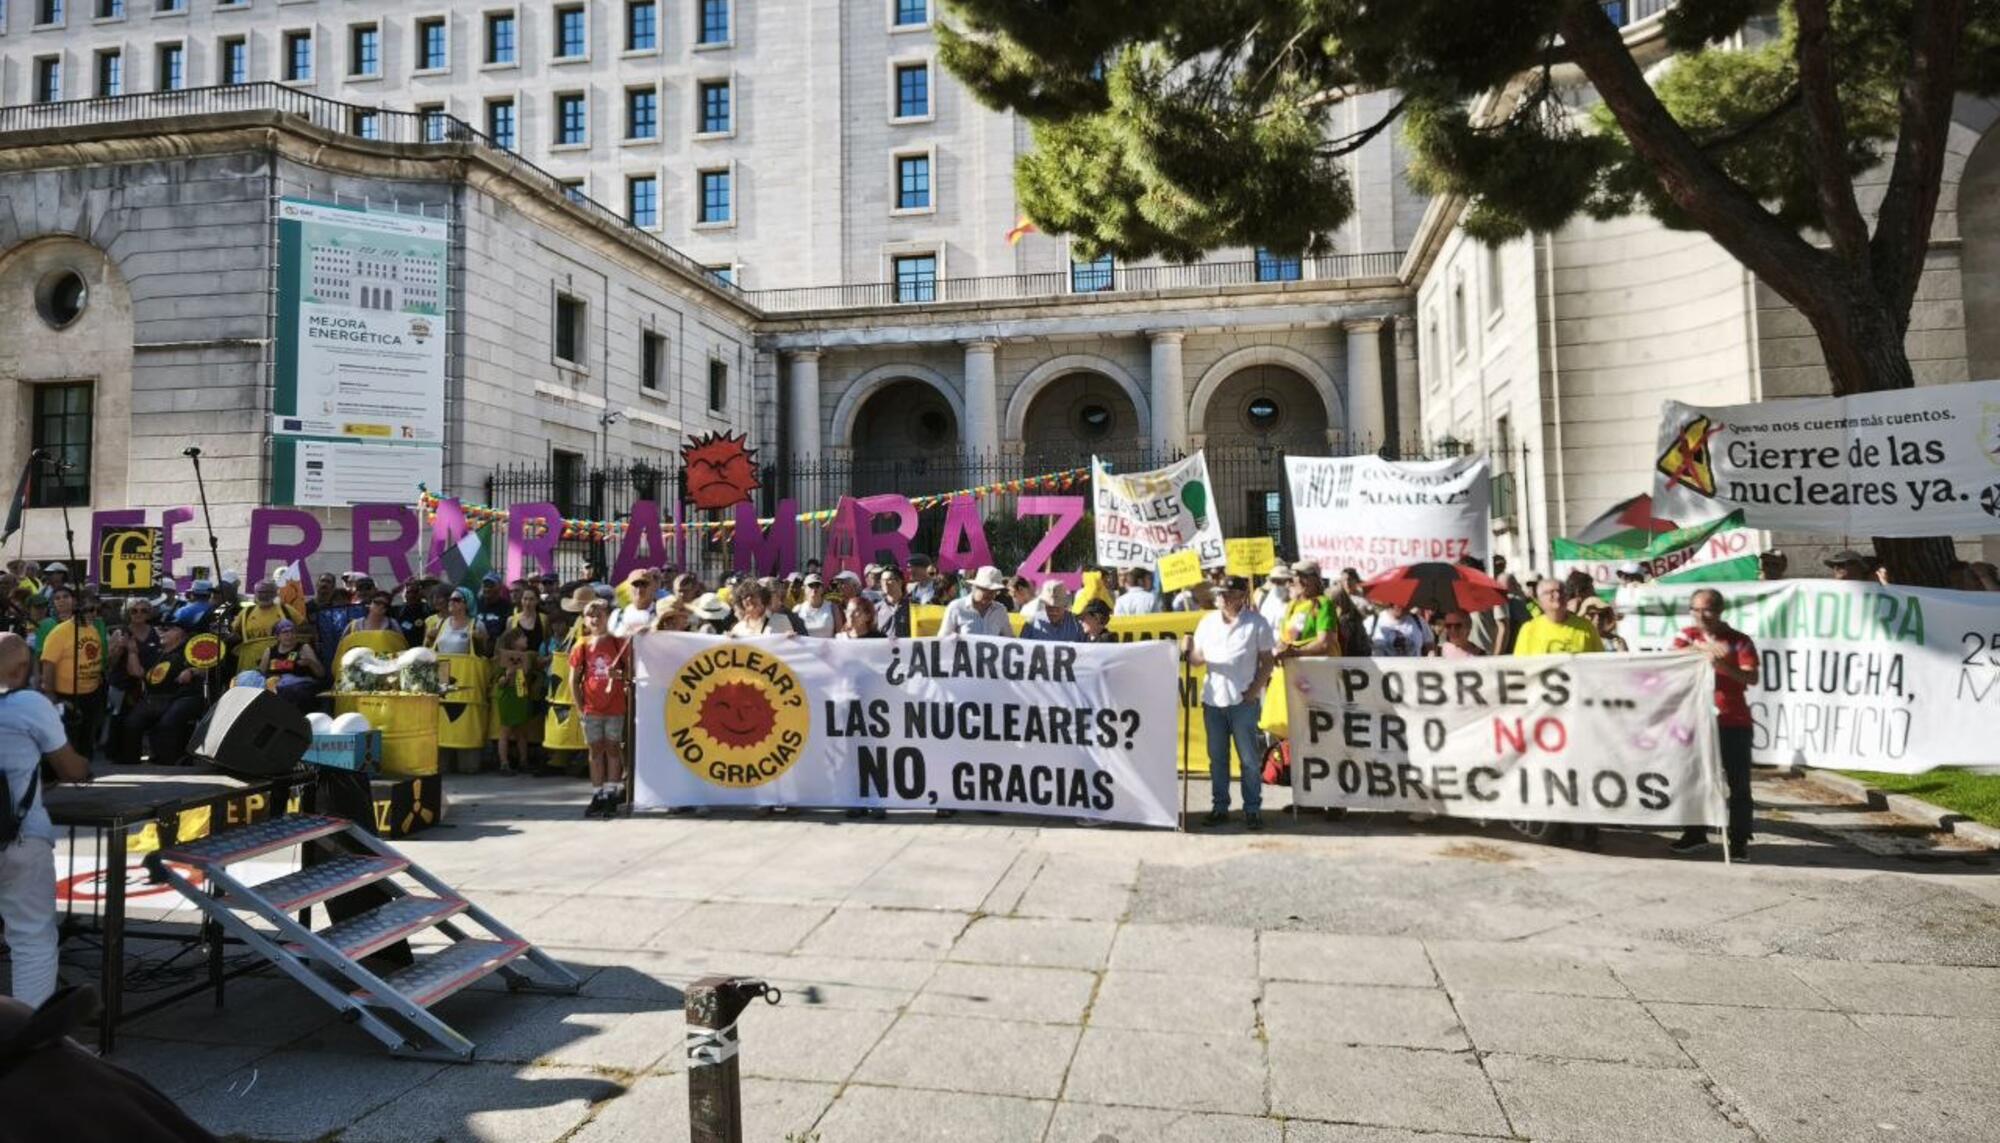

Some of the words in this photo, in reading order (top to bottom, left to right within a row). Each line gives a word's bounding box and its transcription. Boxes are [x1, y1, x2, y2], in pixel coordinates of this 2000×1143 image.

[309, 316, 367, 329] MEJORA
[1772, 420, 1799, 433] nos
[1886, 409, 1956, 426] cuentos.
[1727, 440, 1840, 470] Cierre
[1848, 438, 1880, 468] de
[1887, 436, 1946, 466] las
[1729, 476, 1898, 505] nucleares
[1906, 477, 1970, 511] ya.
[1317, 535, 1364, 553] MAYOR
[1369, 536, 1471, 560] ESTUPIDEZ
[1710, 532, 1747, 559] NO
[677, 649, 801, 707] ¿NUCLEAR?
[886, 641, 1076, 685] ¿ALARGAR
[826, 701, 891, 739] LAS
[905, 702, 1140, 750] NUCLEARES?
[1308, 710, 1447, 751] PERO
[1493, 716, 1568, 754] NO
[1749, 701, 1913, 759] SACRIFICIO
[671, 727, 704, 765] NO
[708, 728, 802, 785] GRACIAS
[858, 746, 938, 805] NO,
[952, 761, 1114, 810] GRACIAS
[1302, 756, 1672, 811] POBRECINOS
